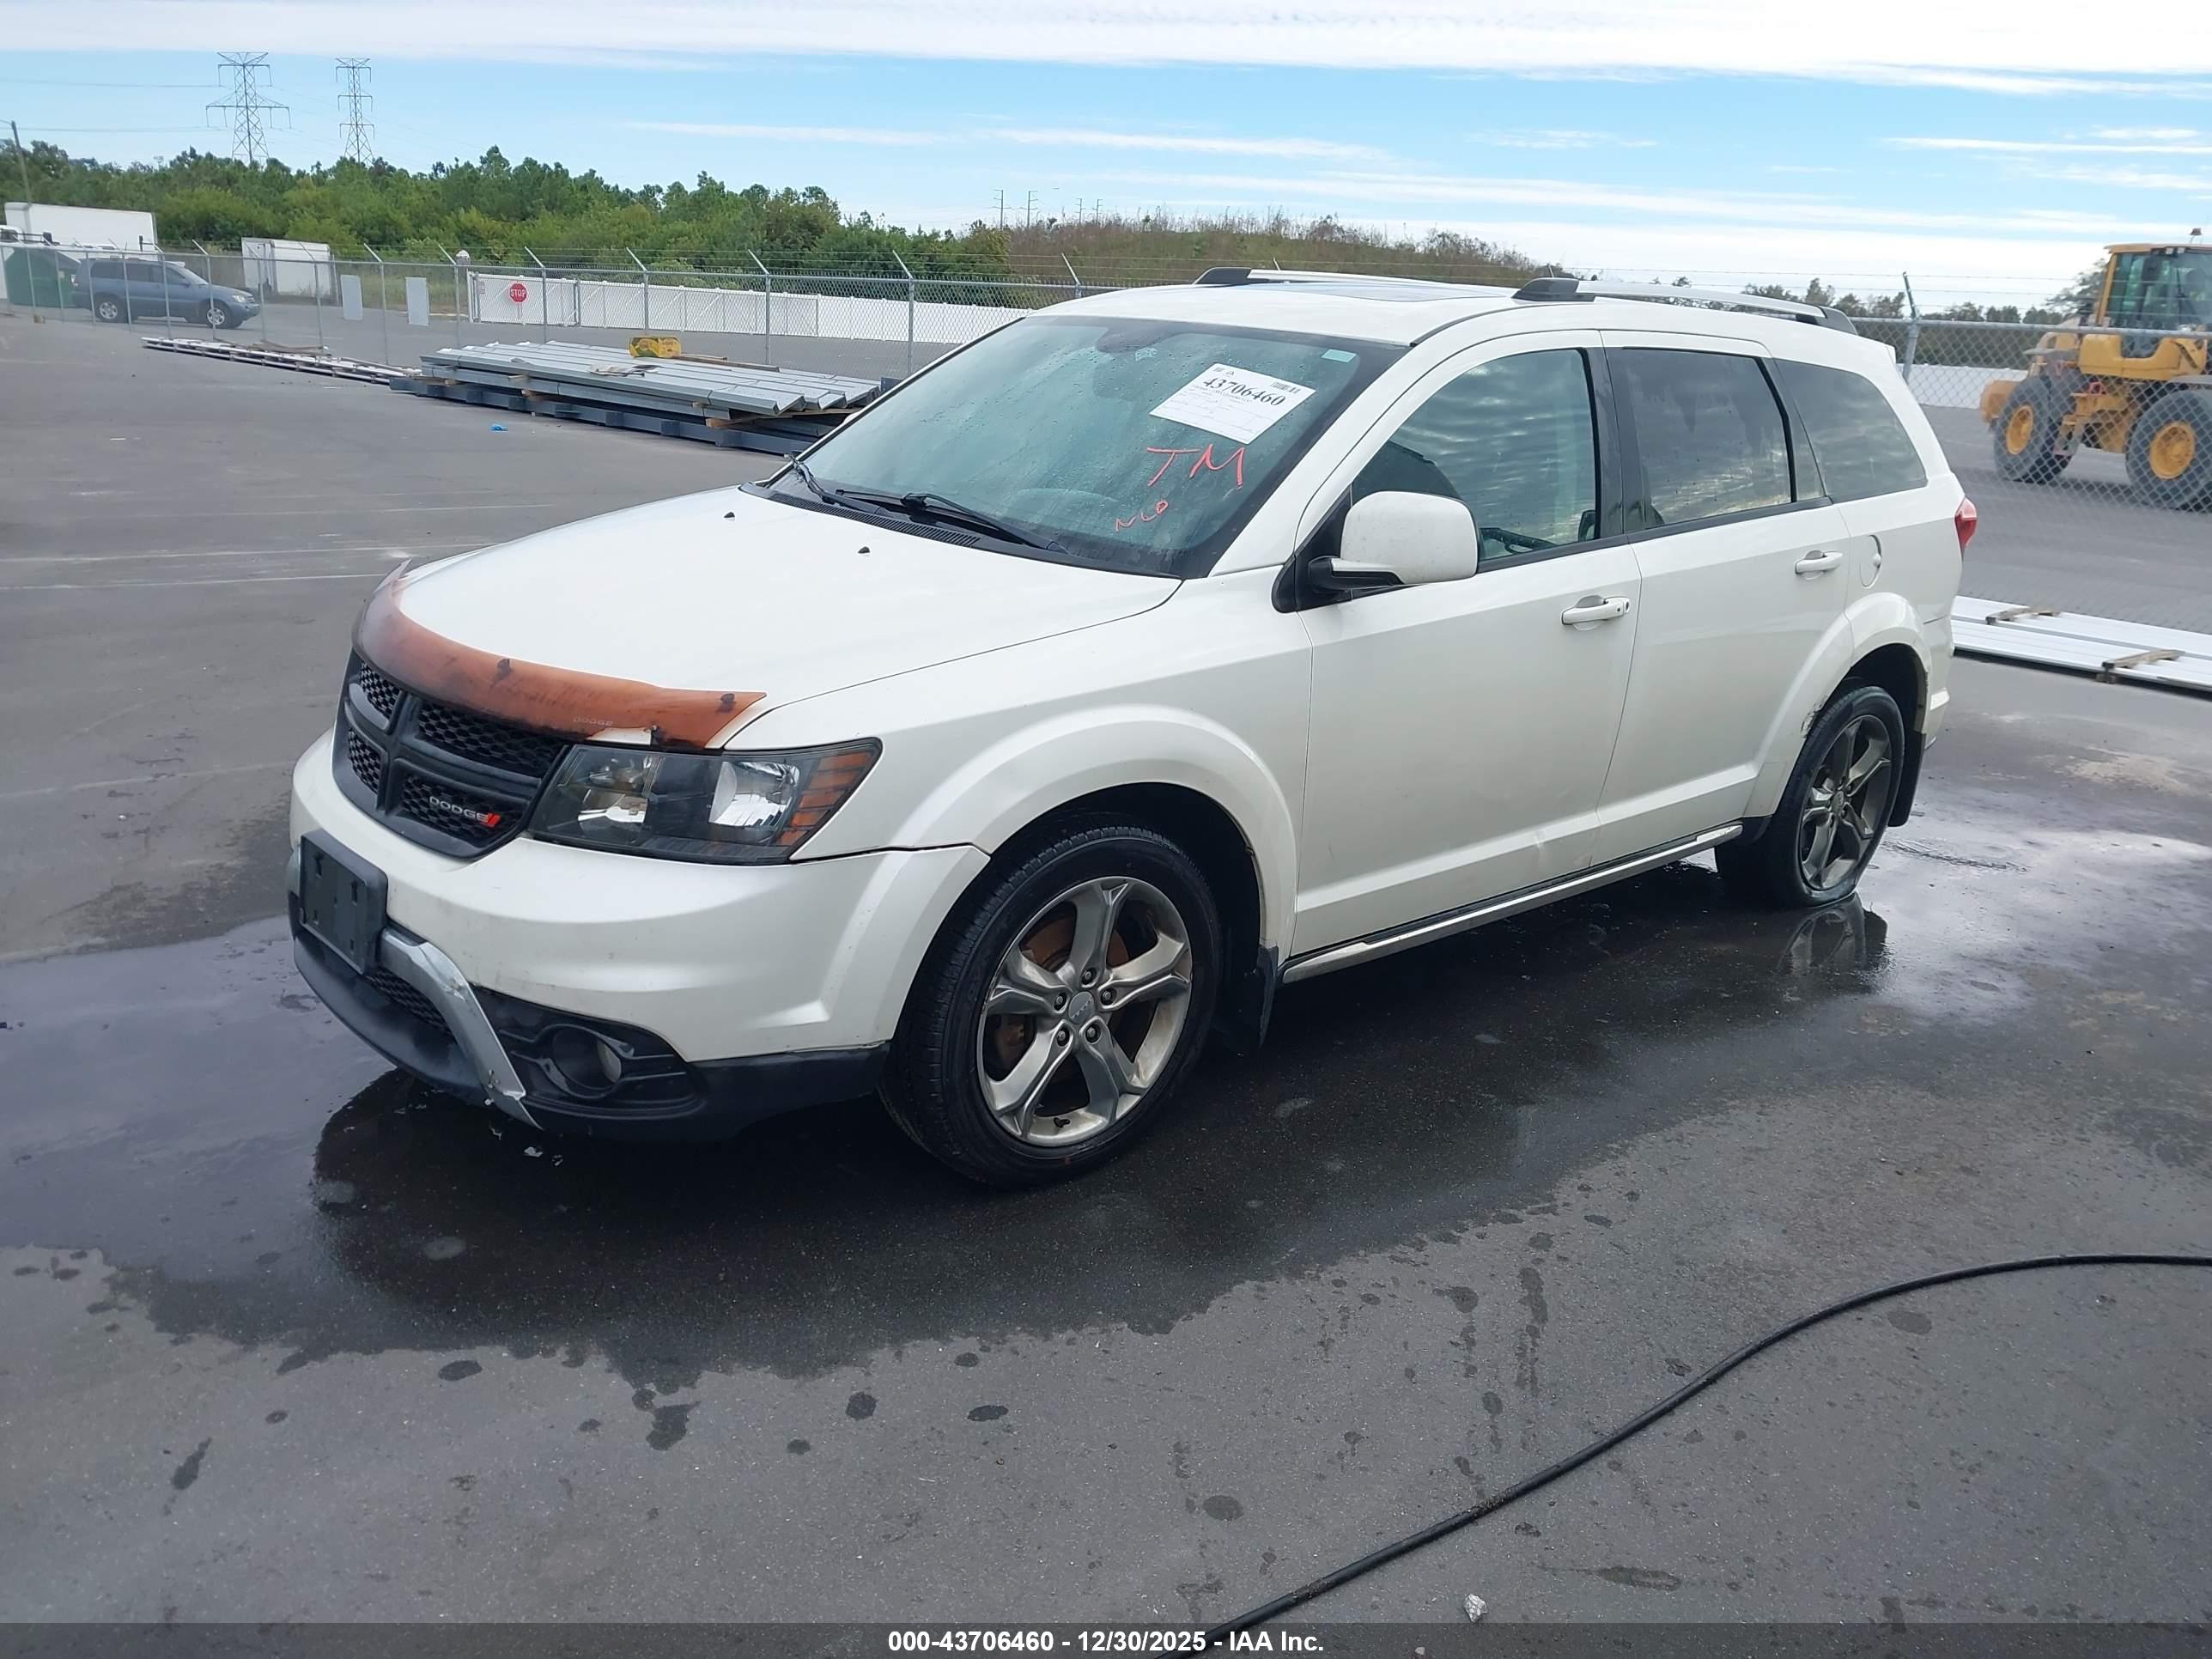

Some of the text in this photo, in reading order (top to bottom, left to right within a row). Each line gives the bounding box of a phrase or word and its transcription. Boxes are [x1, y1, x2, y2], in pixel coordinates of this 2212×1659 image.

[511, 289, 526, 297] STOP
[1203, 377, 1286, 405] 43706460
[1146, 443, 1245, 488] TM
[429, 796, 489, 823] DODGE
